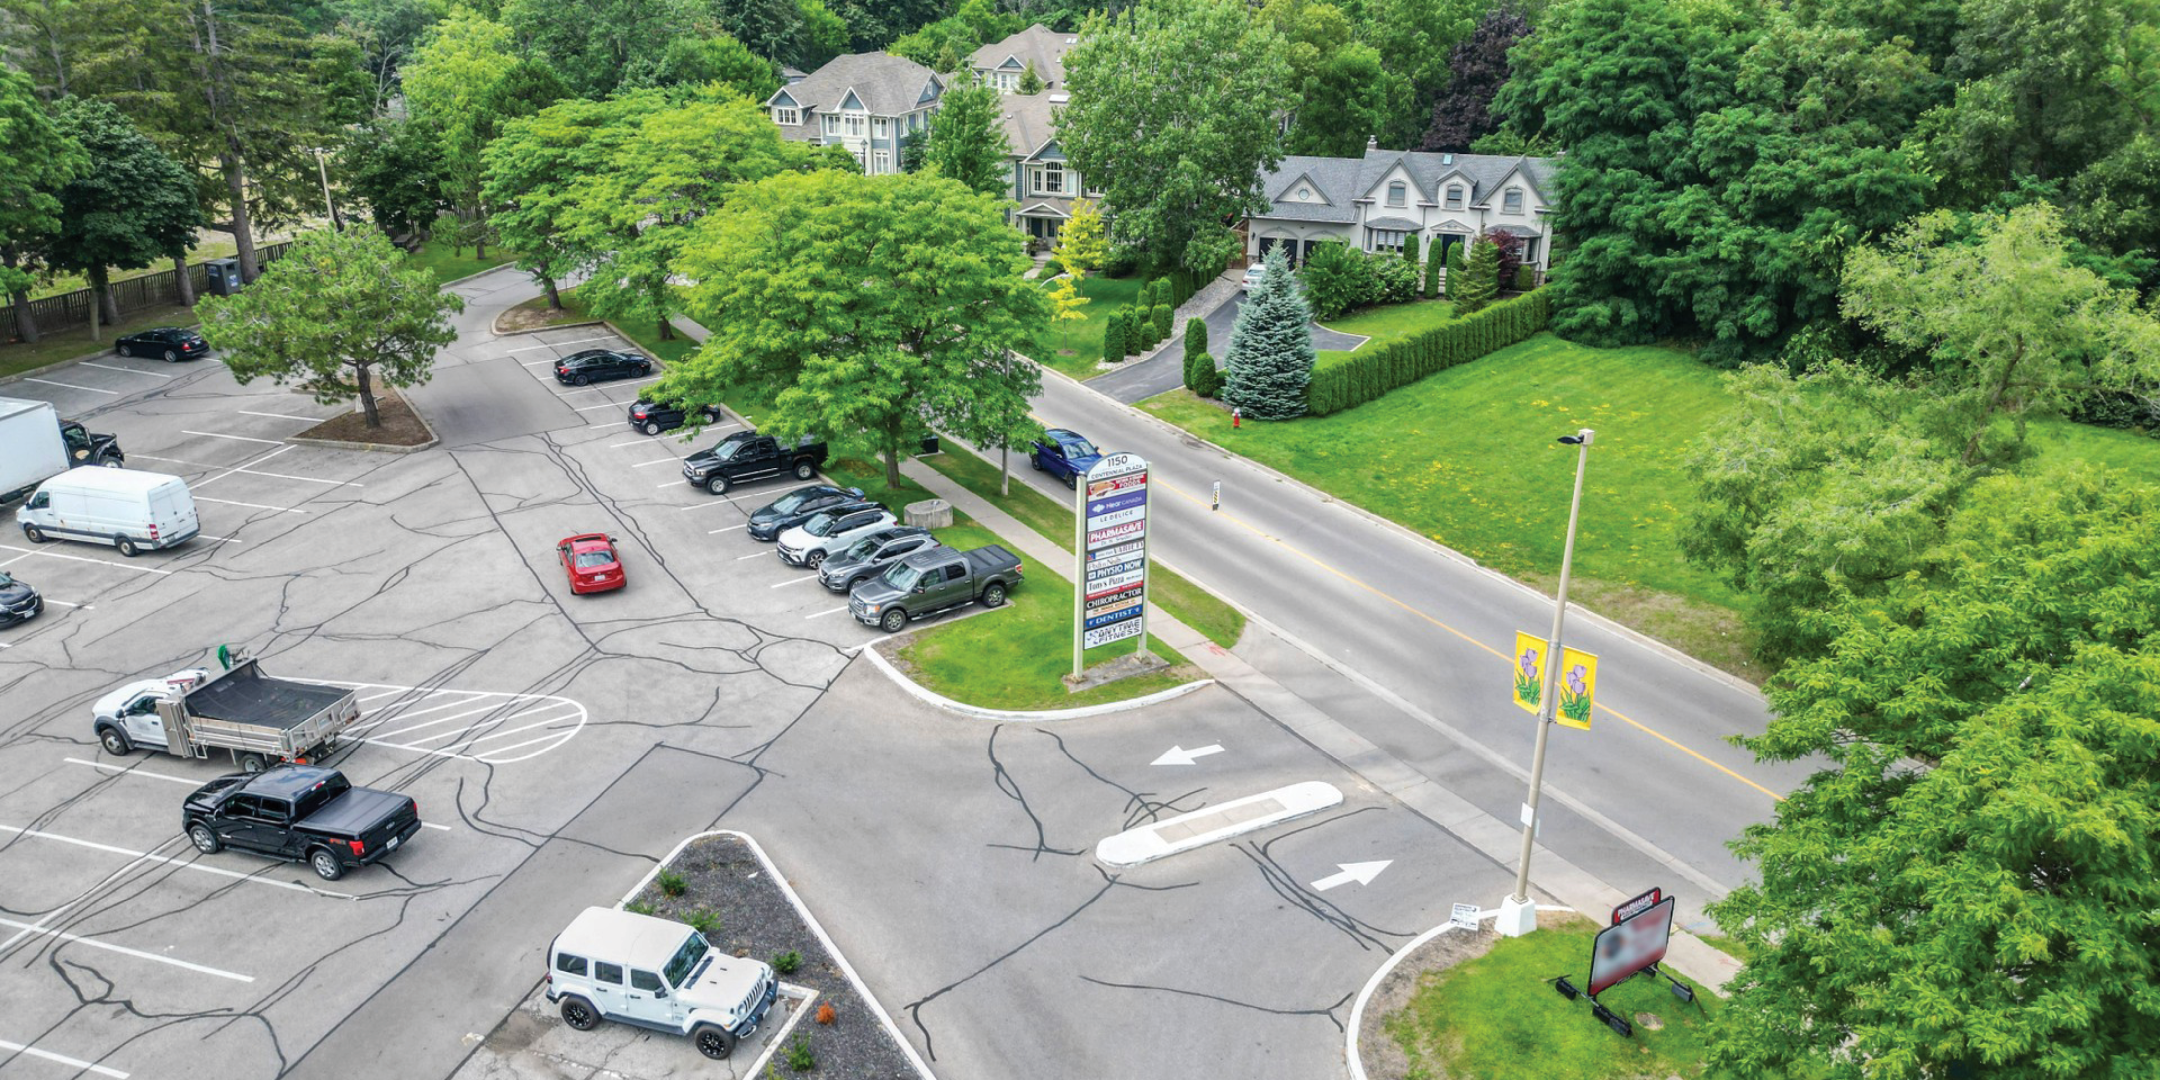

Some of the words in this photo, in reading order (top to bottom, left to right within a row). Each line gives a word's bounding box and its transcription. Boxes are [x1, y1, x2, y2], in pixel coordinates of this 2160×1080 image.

[1107, 455, 1128, 467] 1150
[1091, 469, 1125, 479] CENTENNIAL
[1090, 521, 1142, 541] PHARMASAVE
[1097, 565, 1124, 578] PHYSIO
[1124, 560, 1142, 571] NOW
[1087, 588, 1142, 608] CHIROPRACTOR
[1096, 609, 1132, 623] DENTIST
[1098, 628, 1140, 643] FITNESS
